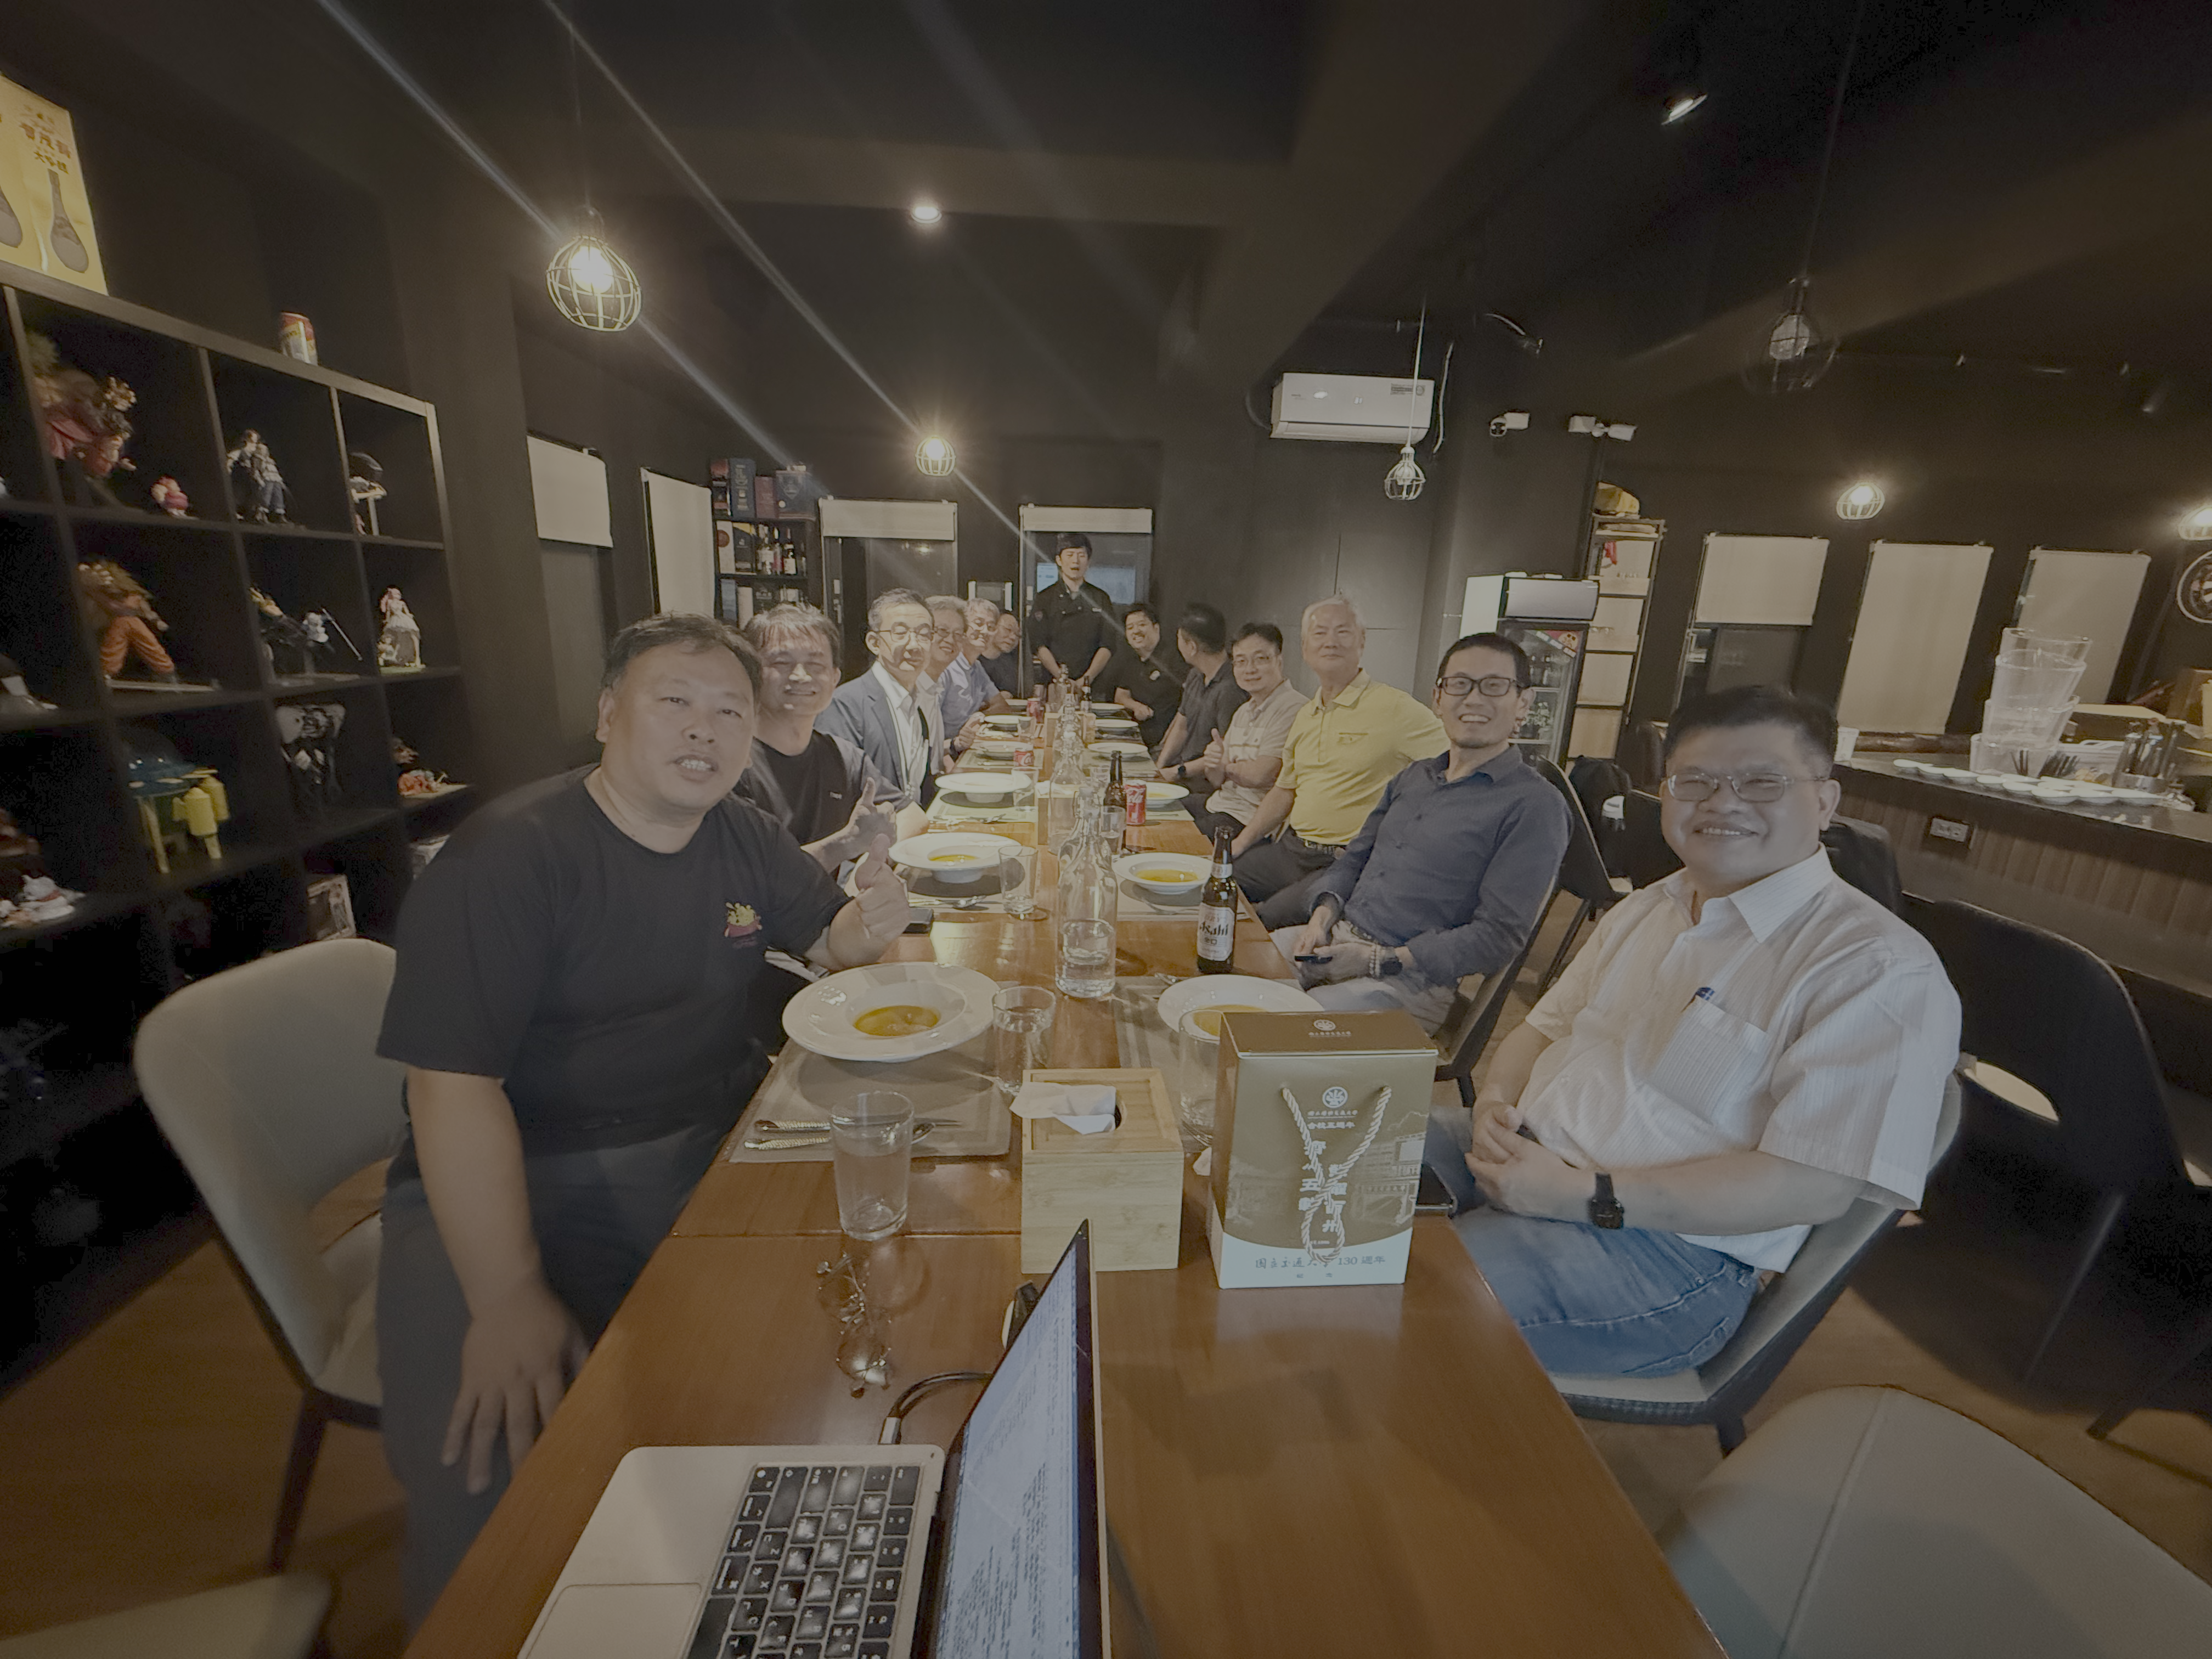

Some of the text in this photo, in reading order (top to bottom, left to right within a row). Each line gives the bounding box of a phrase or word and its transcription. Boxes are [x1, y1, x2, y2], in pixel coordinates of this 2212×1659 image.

[1199, 921, 1229, 936] Asahi
[1338, 1256, 1358, 1266] 130
[1361, 1255, 1386, 1265] 週年
